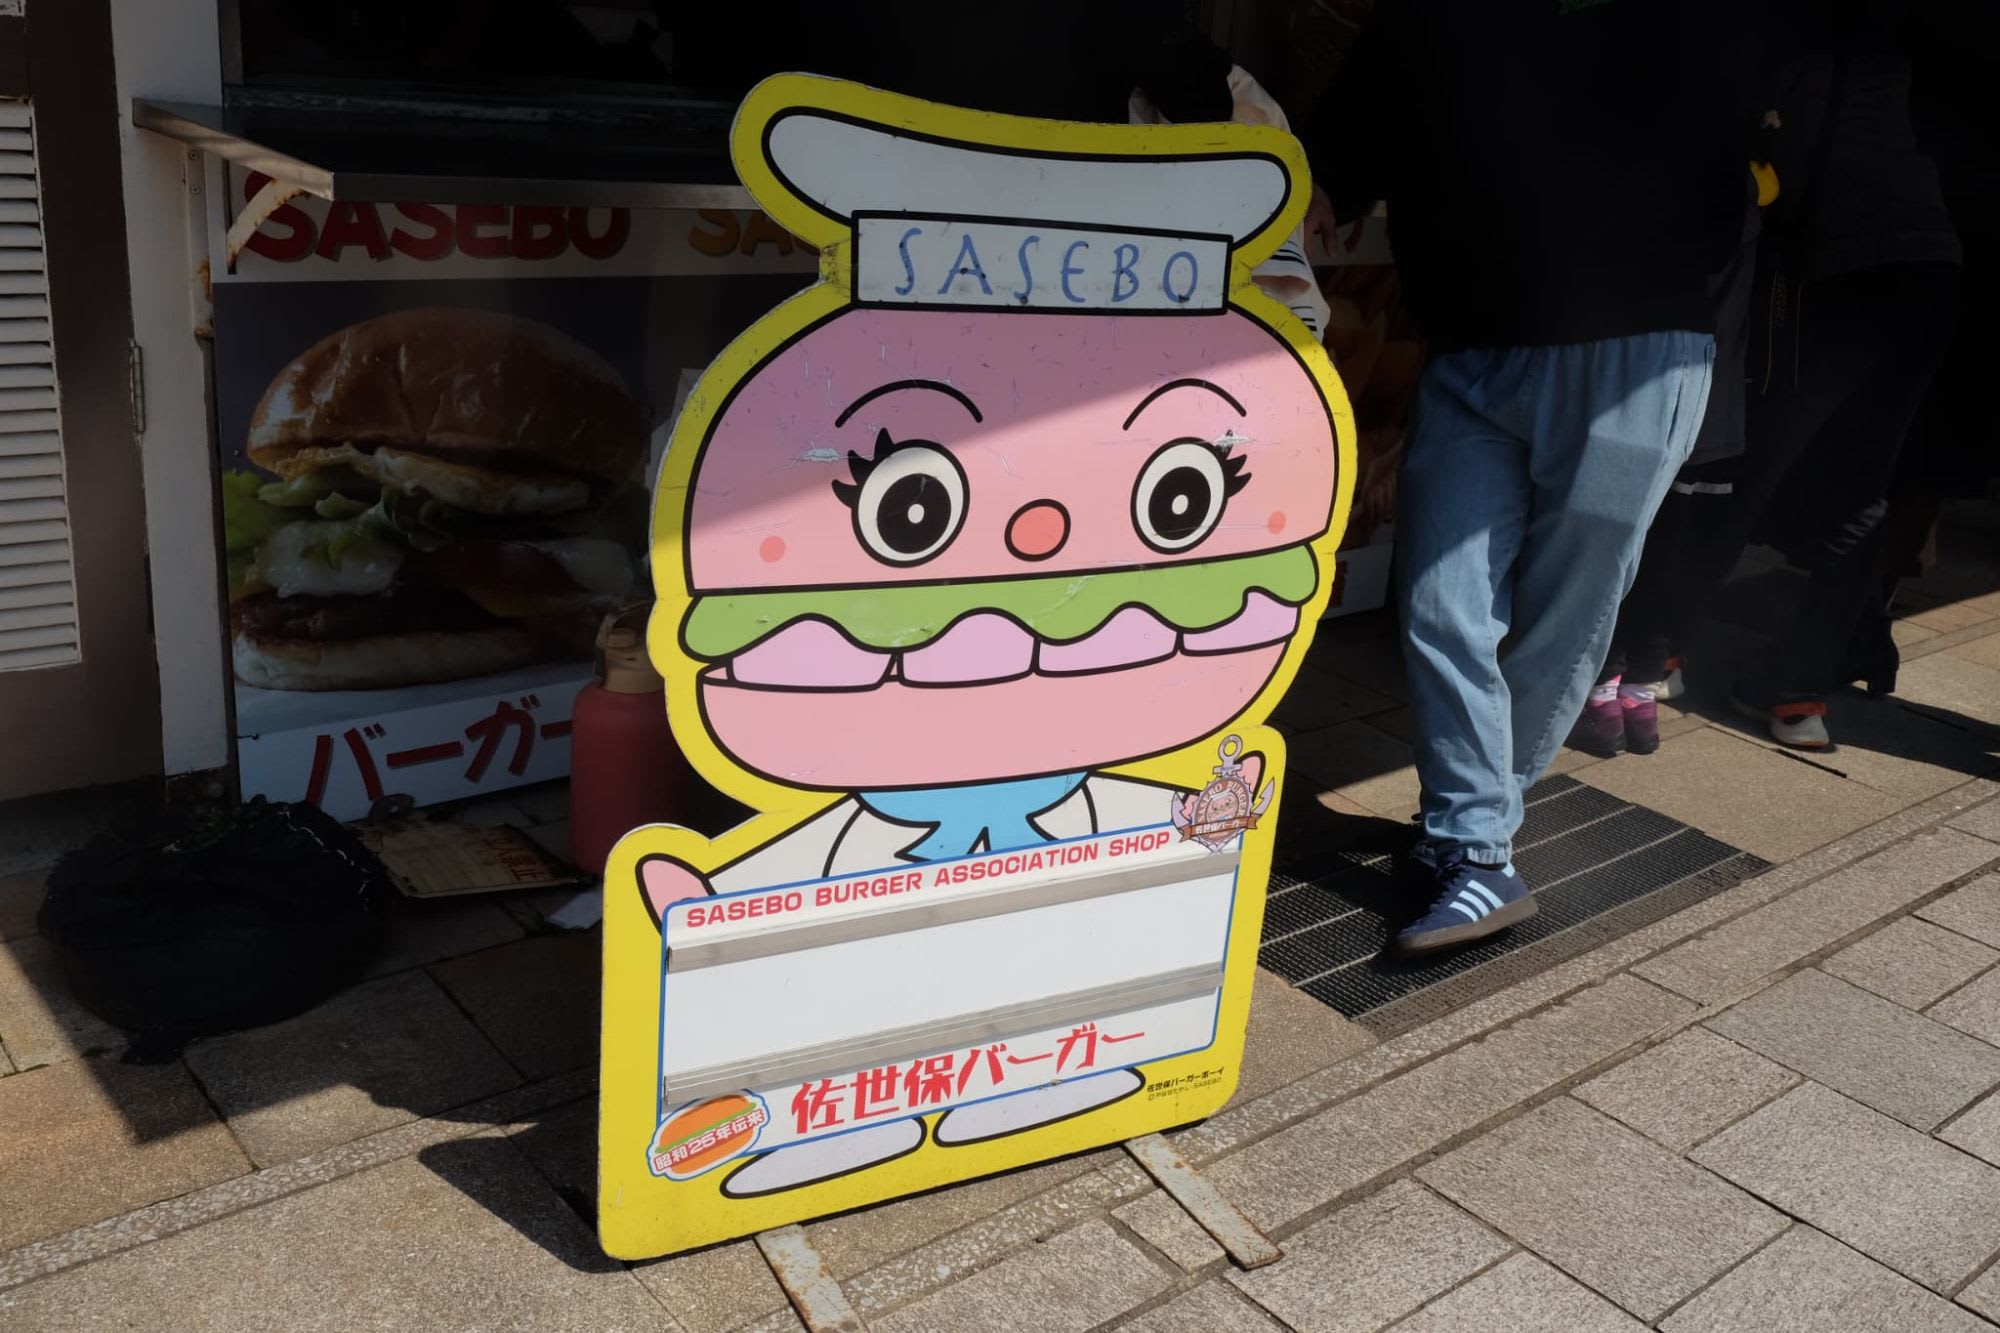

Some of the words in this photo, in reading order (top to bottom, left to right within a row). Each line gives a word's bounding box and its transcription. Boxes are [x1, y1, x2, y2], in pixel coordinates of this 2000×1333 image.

[245, 171, 628, 262] SASEBO
[895, 228, 1199, 304] SASEBO
[687, 892, 803, 928] SASEBO
[815, 872, 922, 907] BURGER
[934, 843, 1099, 887] ASSOCIATION
[1108, 832, 1170, 857] SHOP
[791, 1022, 1145, 1134] 佐世保バーガー
[655, 1110, 764, 1170] 昭和25年伝来
